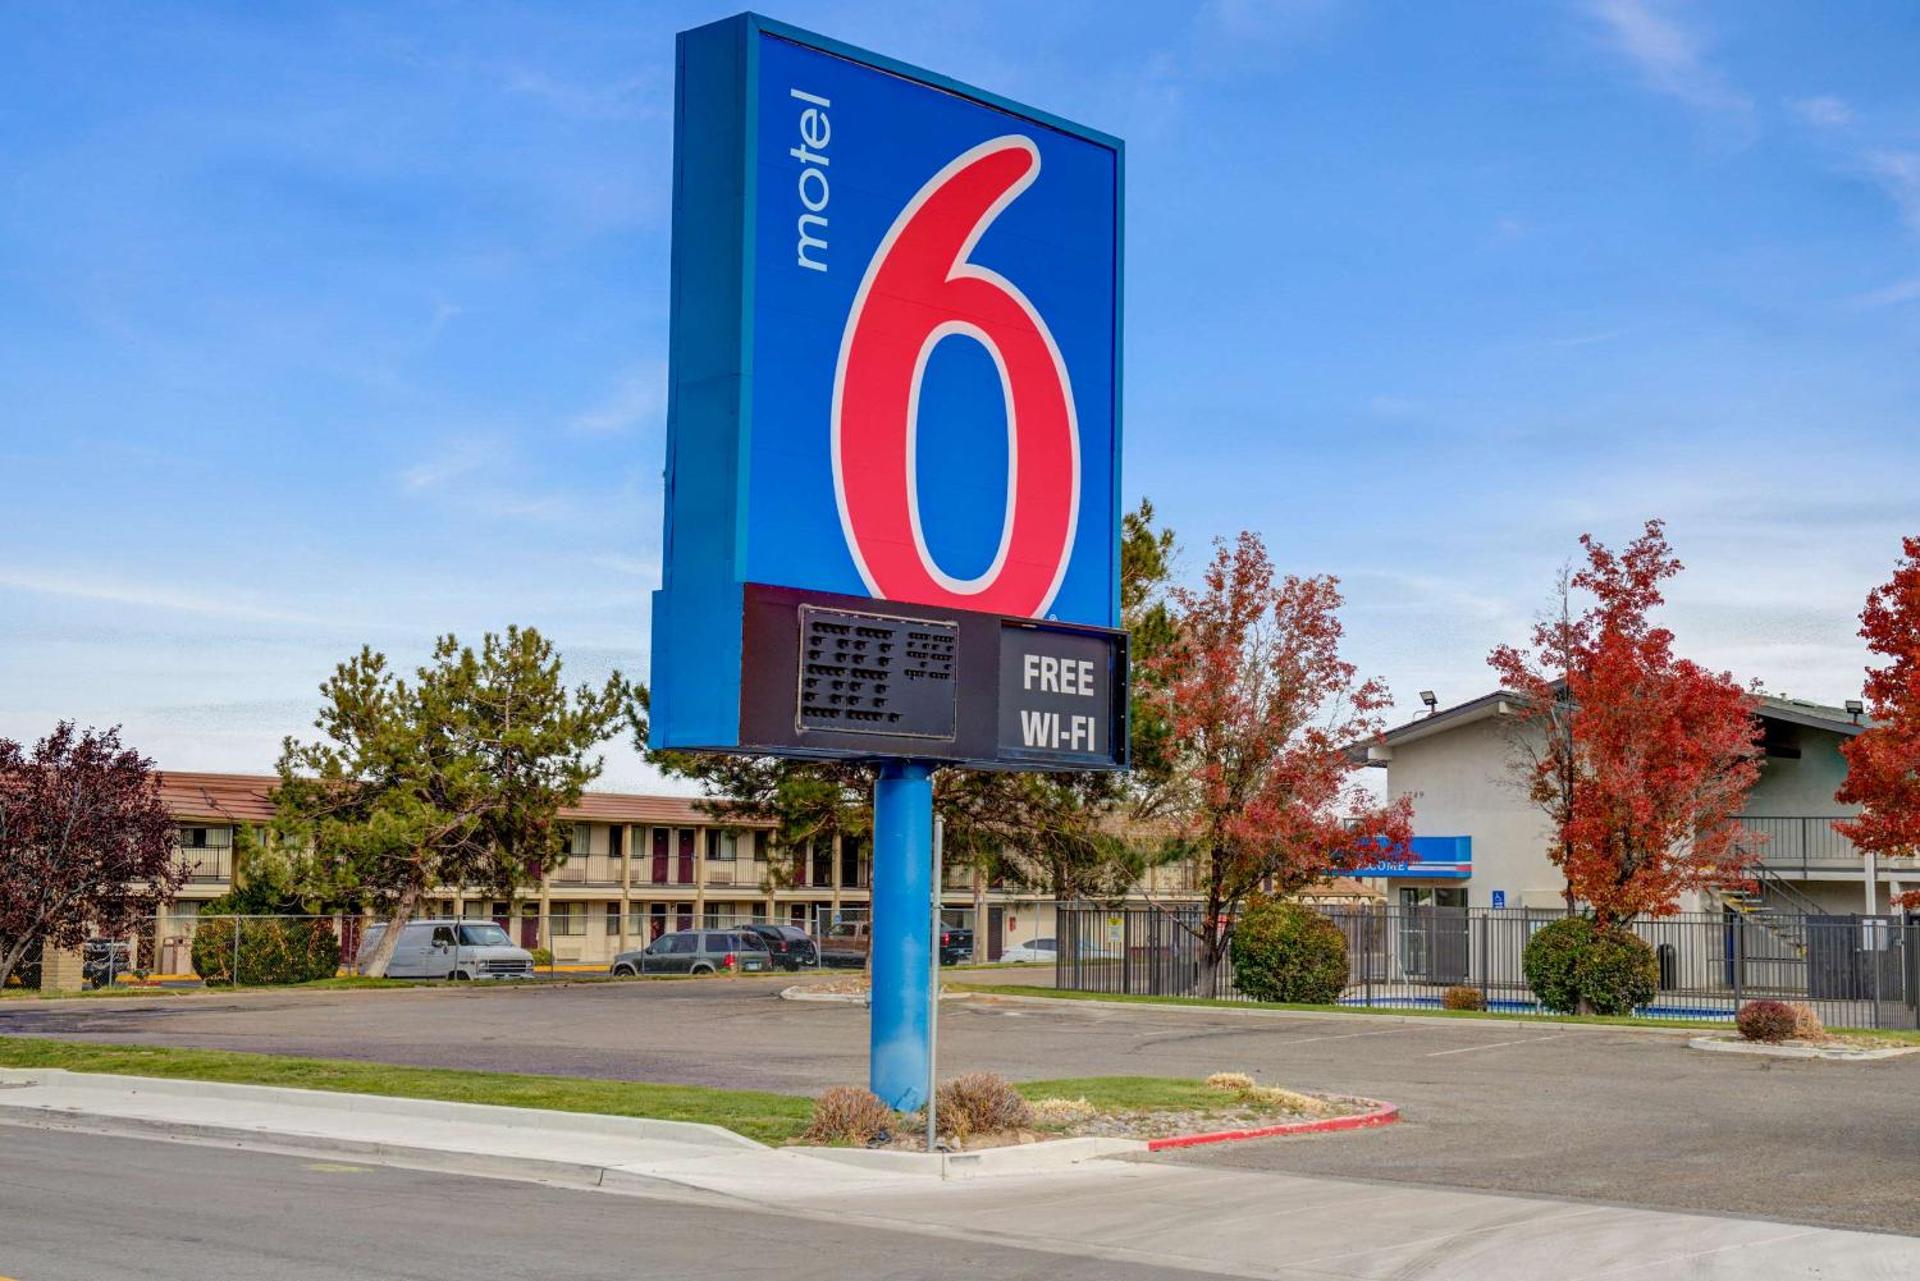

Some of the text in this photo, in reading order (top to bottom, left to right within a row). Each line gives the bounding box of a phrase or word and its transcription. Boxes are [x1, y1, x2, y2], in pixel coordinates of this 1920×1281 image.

[789, 88, 831, 272] motel
[831, 134, 1080, 618] 6
[1020, 710, 1095, 752] WI-FI
[1023, 654, 1094, 696] FREE
